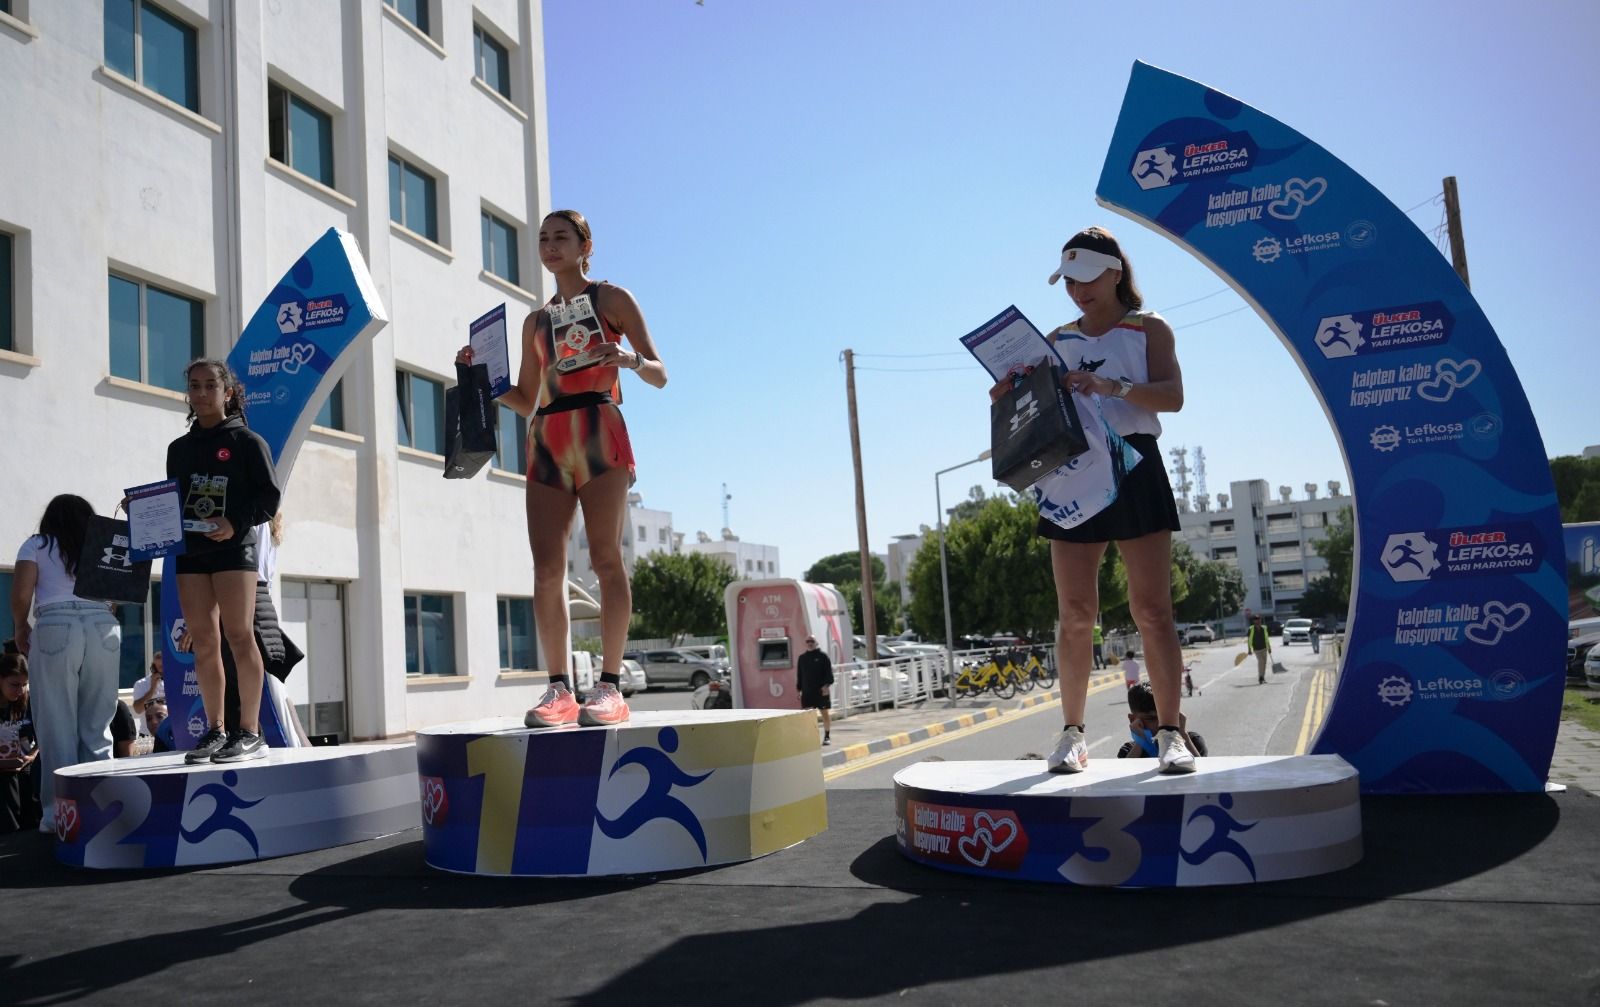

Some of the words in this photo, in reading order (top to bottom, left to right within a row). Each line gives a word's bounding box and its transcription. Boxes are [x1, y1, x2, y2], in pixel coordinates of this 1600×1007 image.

[1184, 140, 1228, 157] ÜLKER
[1183, 148, 1248, 169] LEFKOŞA
[1183, 168, 1201, 178] YARI
[1202, 160, 1247, 175] MARATONU
[1208, 190, 1248, 210] kalpten
[1251, 184, 1282, 202] kalbe
[1206, 205, 1263, 228] koşuyoruz
[1286, 230, 1340, 248] Lefkoşa
[306, 306, 344, 320] LEFKOŞA
[1372, 311, 1420, 326] ÜLKER
[1371, 319, 1443, 339] LEFKOŞA
[1371, 339, 1391, 348] YARI
[1392, 332, 1443, 345] MARATONU
[1352, 368, 1395, 388] kalpten
[1399, 363, 1431, 382] kalbe
[245, 391, 271, 401] efkoşa
[1350, 385, 1412, 408] koşuyoruz
[1405, 421, 1463, 437] Lefkoşa
[1450, 531, 1506, 546] ÜLKER
[1448, 543, 1533, 561] LEFKOŞA
[1448, 564, 1471, 572] YARI
[1473, 559, 1533, 570] MARATONU
[762, 595, 781, 604] ATM
[1398, 606, 1442, 626] kalpten
[1446, 603, 1479, 622] kalbe
[1395, 626, 1458, 646] koşuyoruz
[1417, 677, 1482, 691] Lefkoşa
[466, 735, 530, 875] 1
[84, 777, 152, 868] 2
[1057, 796, 1144, 887] 3
